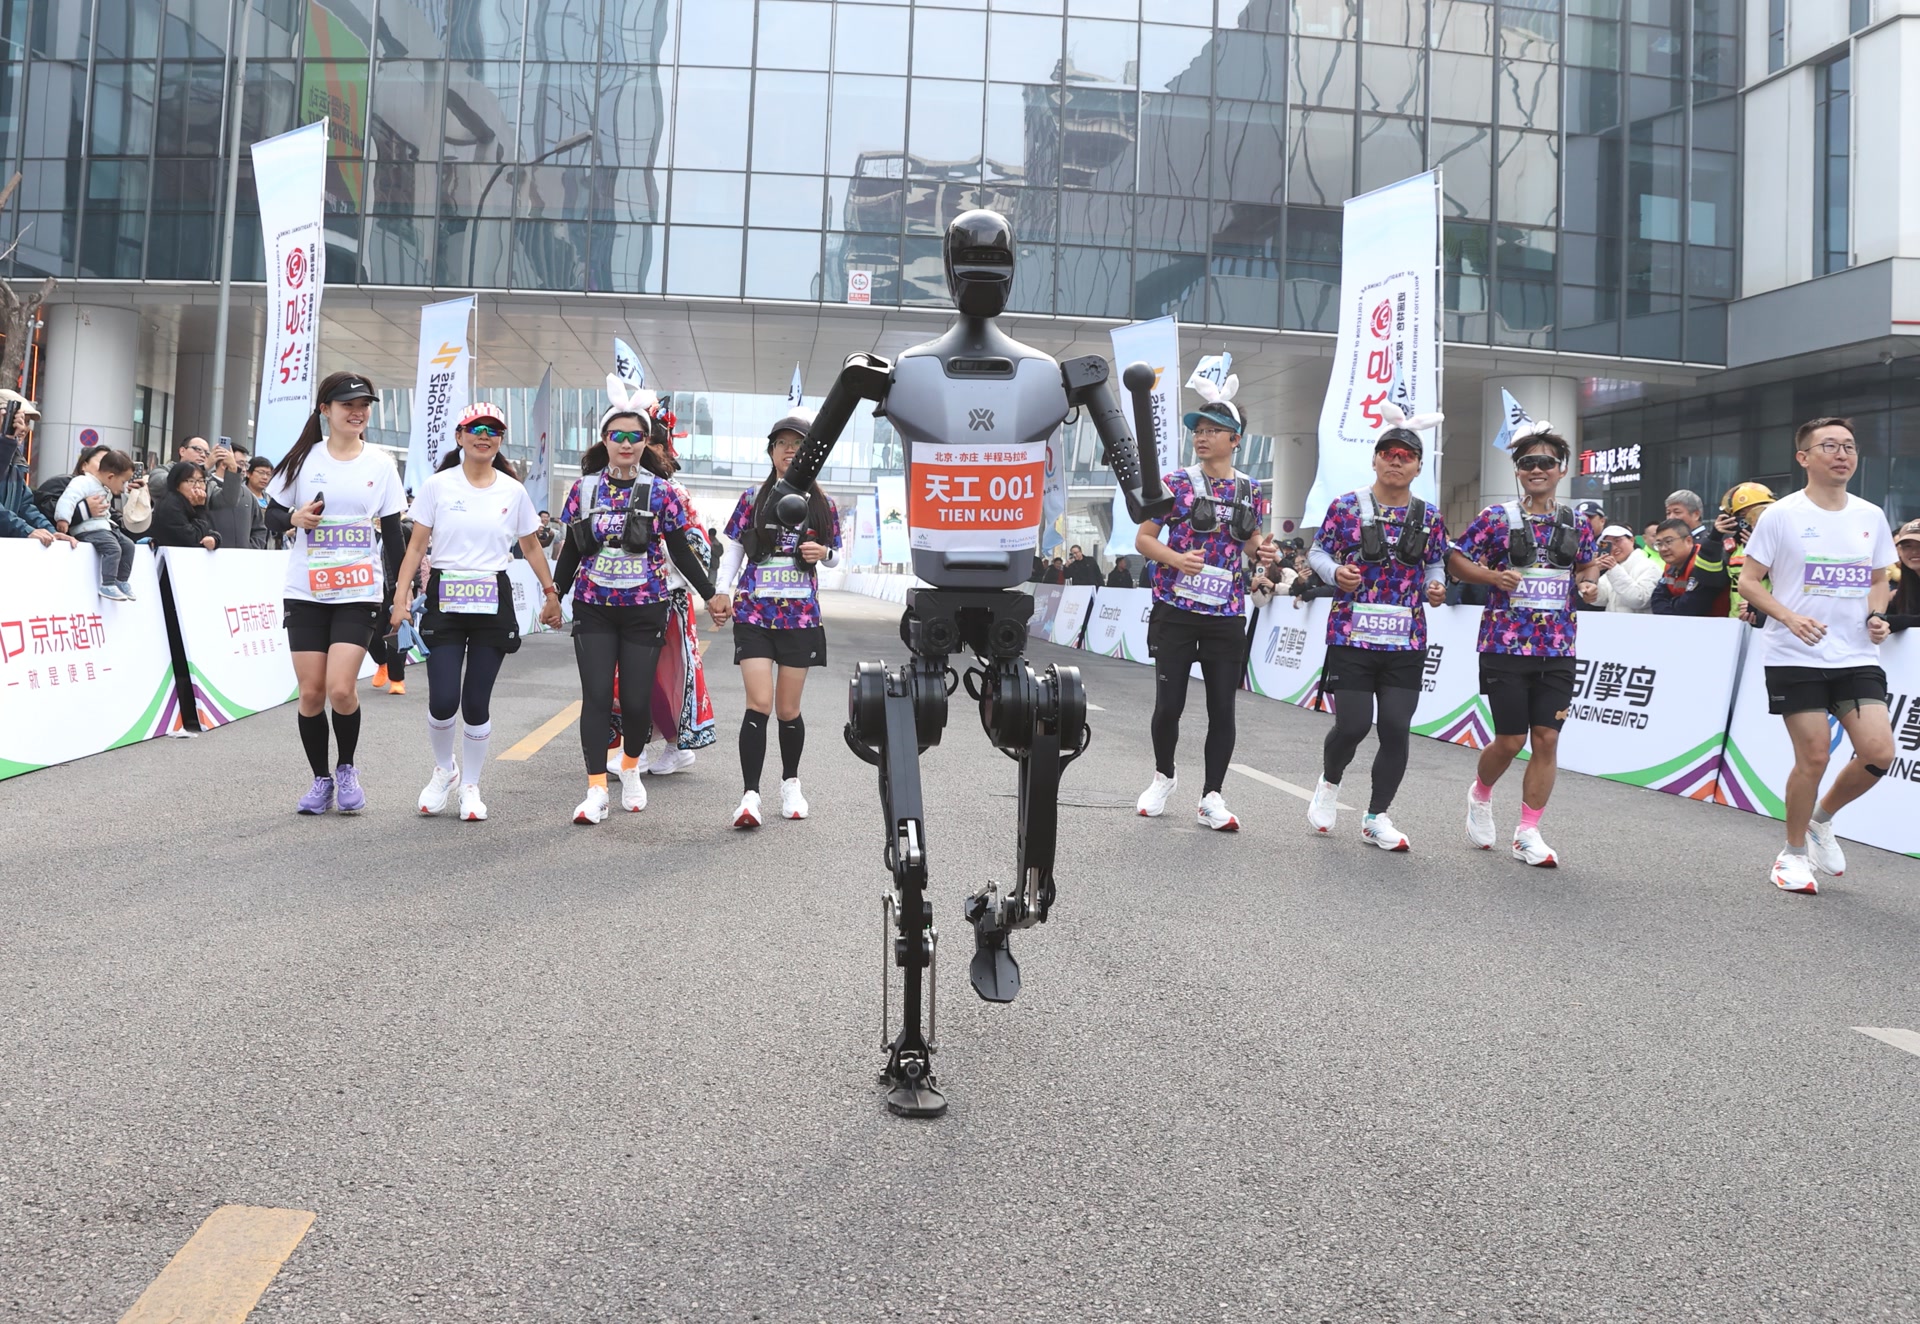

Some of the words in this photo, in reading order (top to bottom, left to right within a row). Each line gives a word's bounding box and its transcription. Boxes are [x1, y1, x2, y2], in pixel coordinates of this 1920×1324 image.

[935, 451, 979, 462] 北京·亦庄
[983, 451, 1028, 462] 半程马拉松
[924, 473, 981, 503] 天工
[989, 474, 1035, 501] 001
[938, 508, 975, 522] TIEN
[980, 508, 1024, 522] KUNG
[314, 529, 364, 542] B1163
[595, 557, 643, 575] B2235
[1810, 566, 1867, 582] A7933
[334, 568, 369, 586] 3:10
[1181, 574, 1227, 593] A8137
[445, 583, 494, 598] B2067
[1515, 580, 1564, 596] A7061
[239, 602, 278, 633] 京东超市
[1098, 604, 1122, 622] Casarte
[1356, 614, 1405, 632] A5581
[28, 612, 105, 655] 京东超市
[1277, 626, 1308, 656] 引擎鸟
[28, 662, 96, 690] 就是便宜
